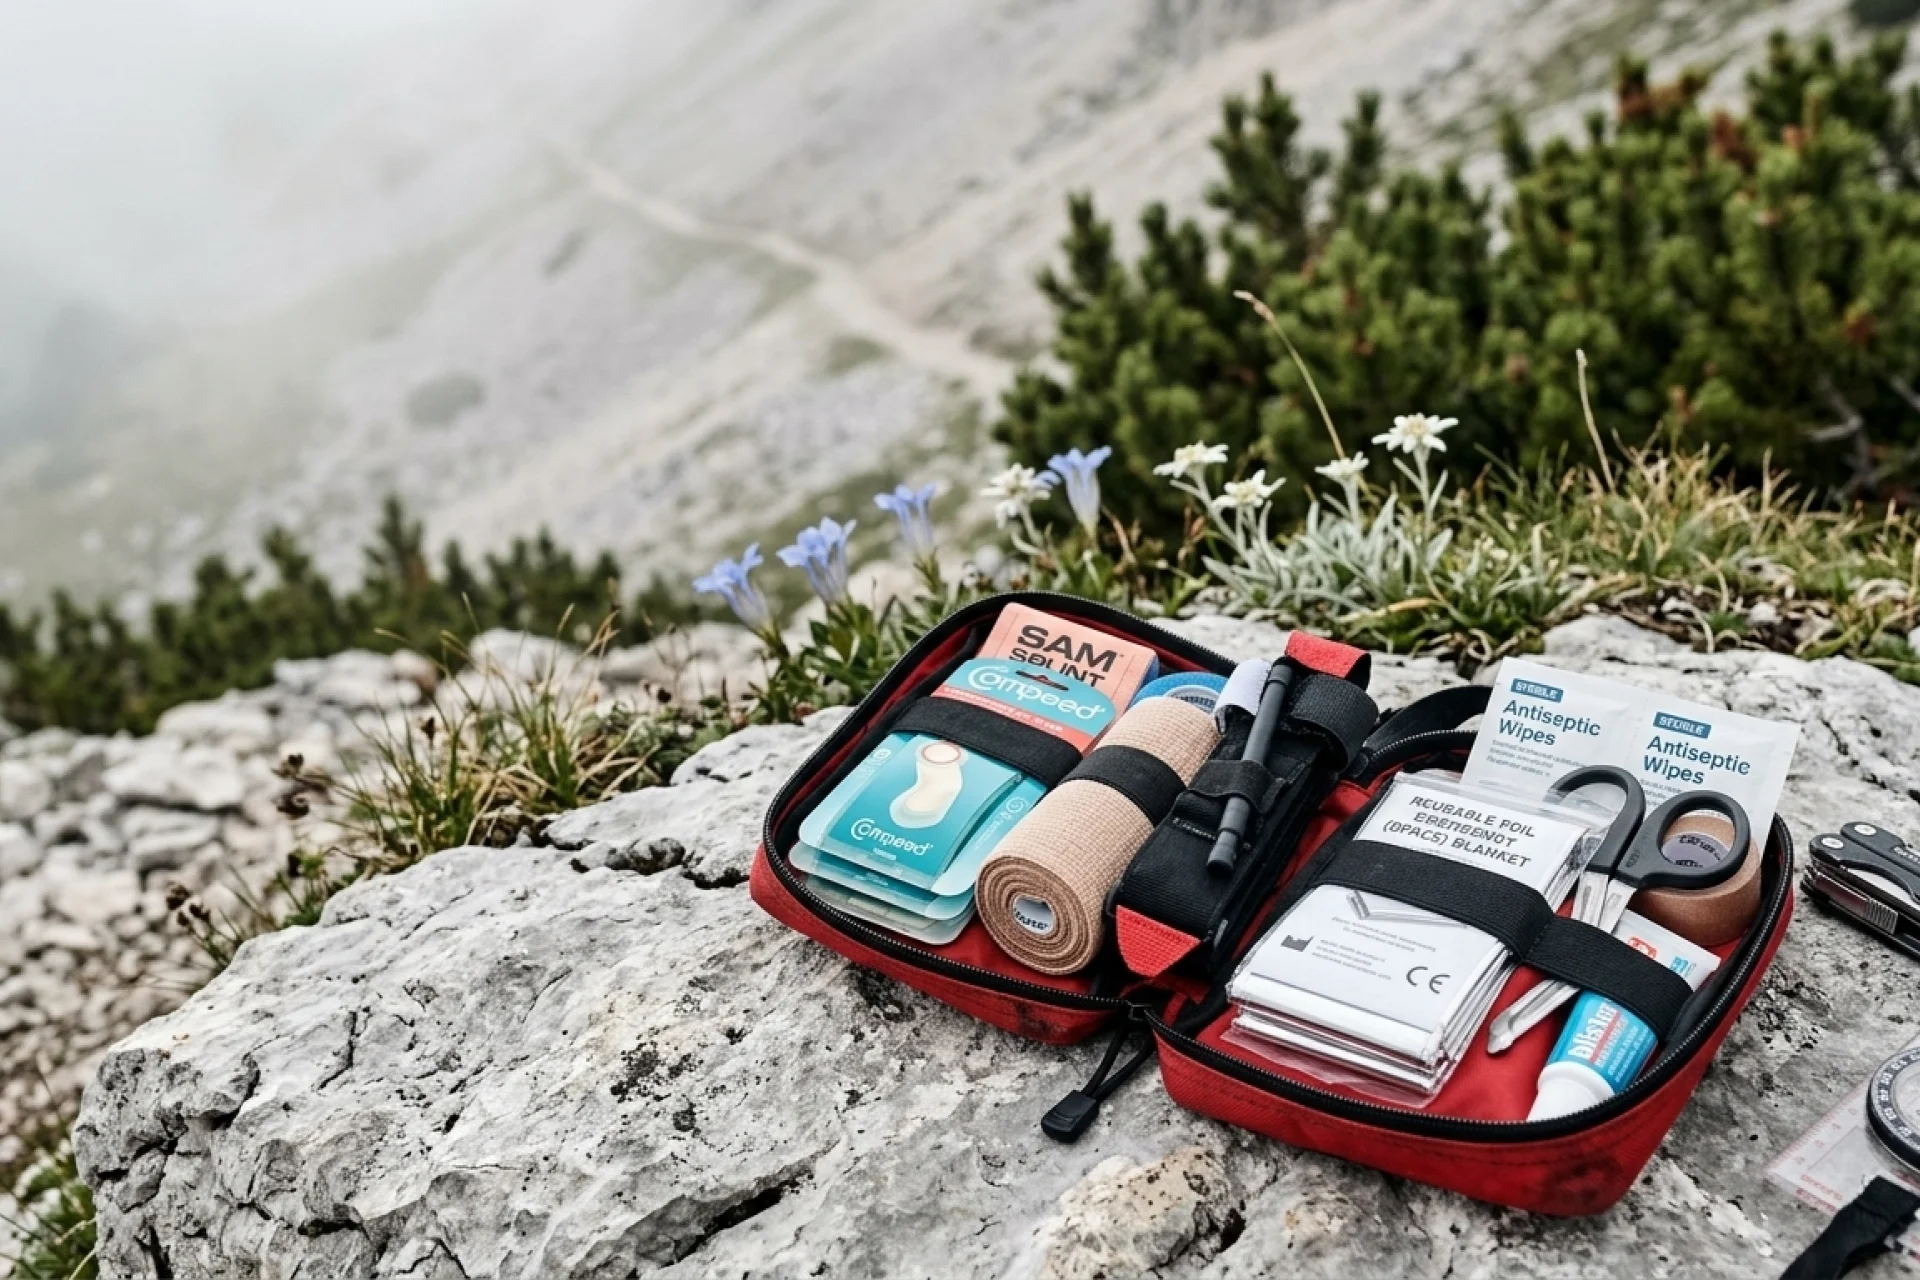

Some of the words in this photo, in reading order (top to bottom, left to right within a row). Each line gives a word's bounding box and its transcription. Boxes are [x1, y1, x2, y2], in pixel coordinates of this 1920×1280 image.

[1017, 624, 1118, 673] SAM
[1499, 717, 1556, 746] Wipes
[1502, 699, 1600, 736] Antiseptic
[1643, 754, 1705, 784] Wipes
[1646, 735, 1751, 775] Antiseptic
